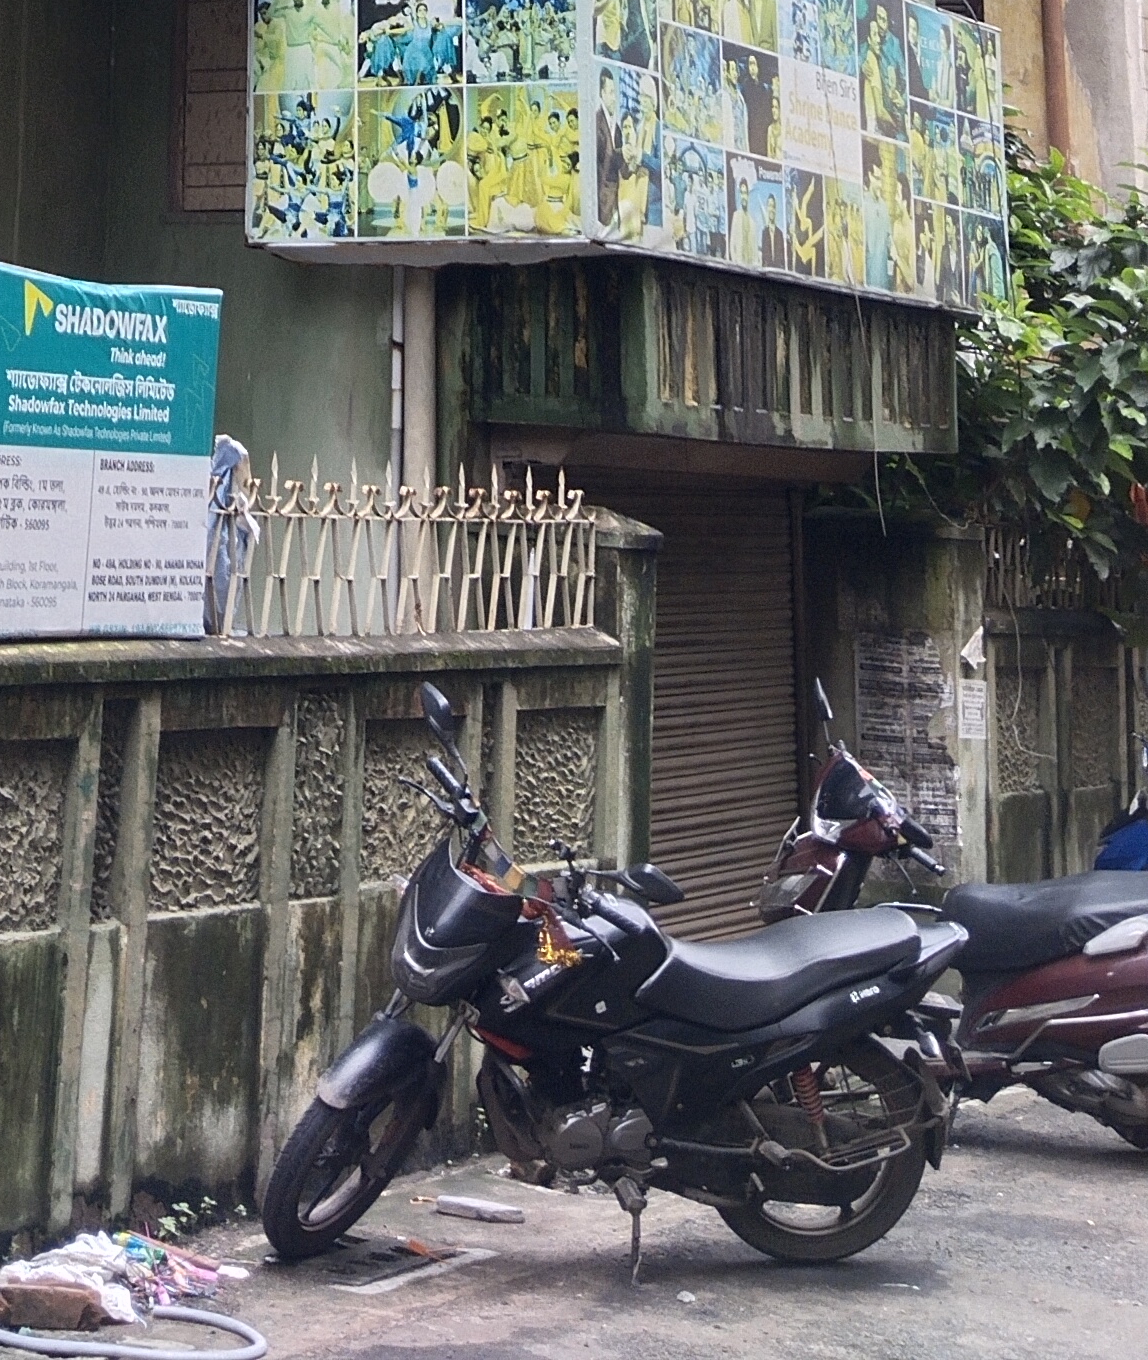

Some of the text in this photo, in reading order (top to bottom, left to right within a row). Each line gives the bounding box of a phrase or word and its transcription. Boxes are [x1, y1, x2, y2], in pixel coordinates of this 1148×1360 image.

[54, 303, 167, 343] SHADOWFAX
[111, 347, 166, 368] Think ahead!
[8, 394, 170, 424] Shadowfax Technologies Limited
[100, 458, 125, 472] BRANCH
